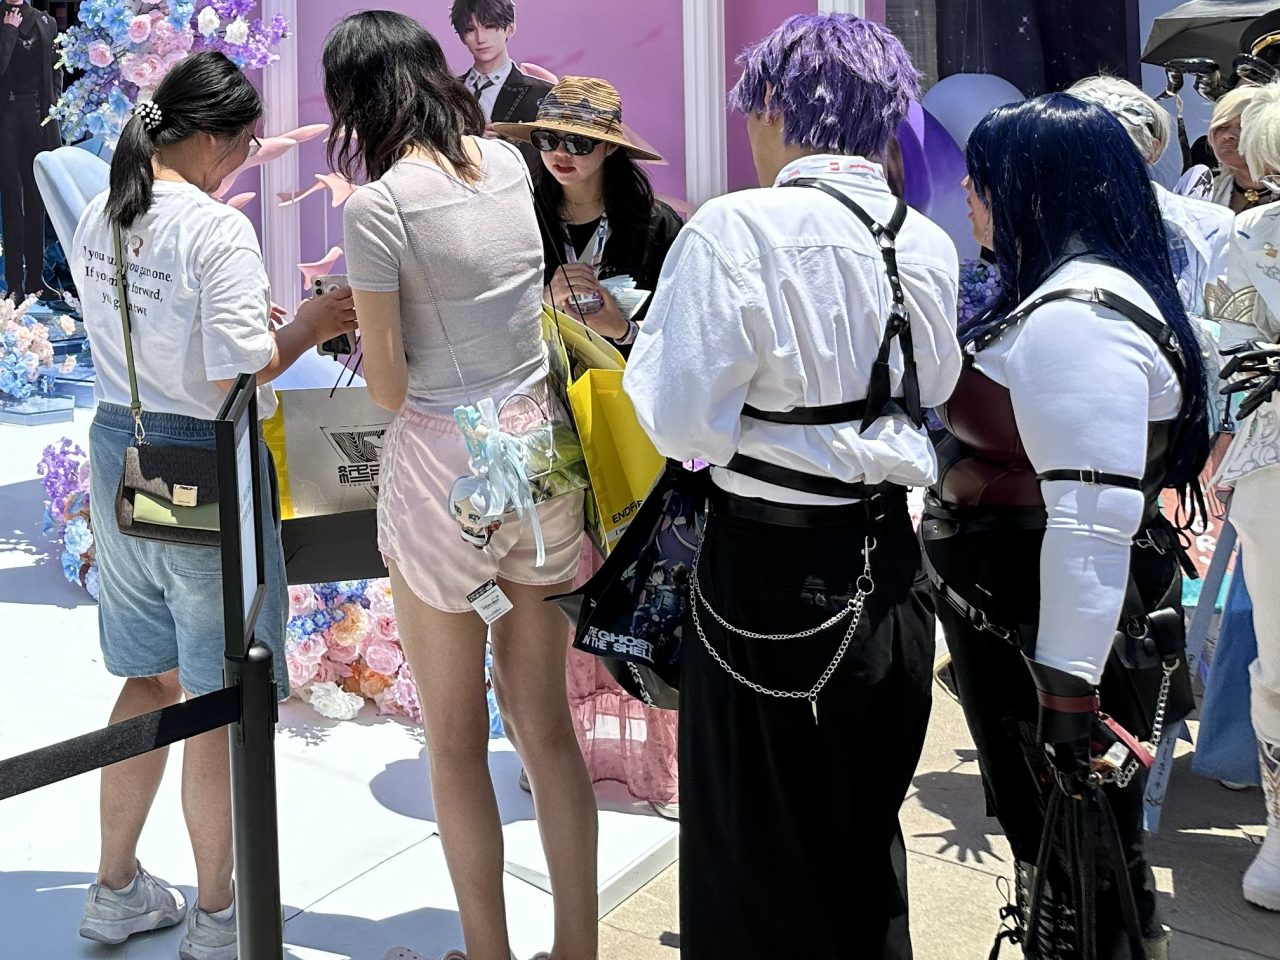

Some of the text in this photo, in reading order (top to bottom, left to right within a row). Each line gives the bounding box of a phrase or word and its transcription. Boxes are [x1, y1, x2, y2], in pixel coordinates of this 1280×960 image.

[85, 266, 95, 277] If
[152, 270, 173, 283] one.
[591, 637, 608, 650] THE
[597, 630, 655, 652] GHOST
